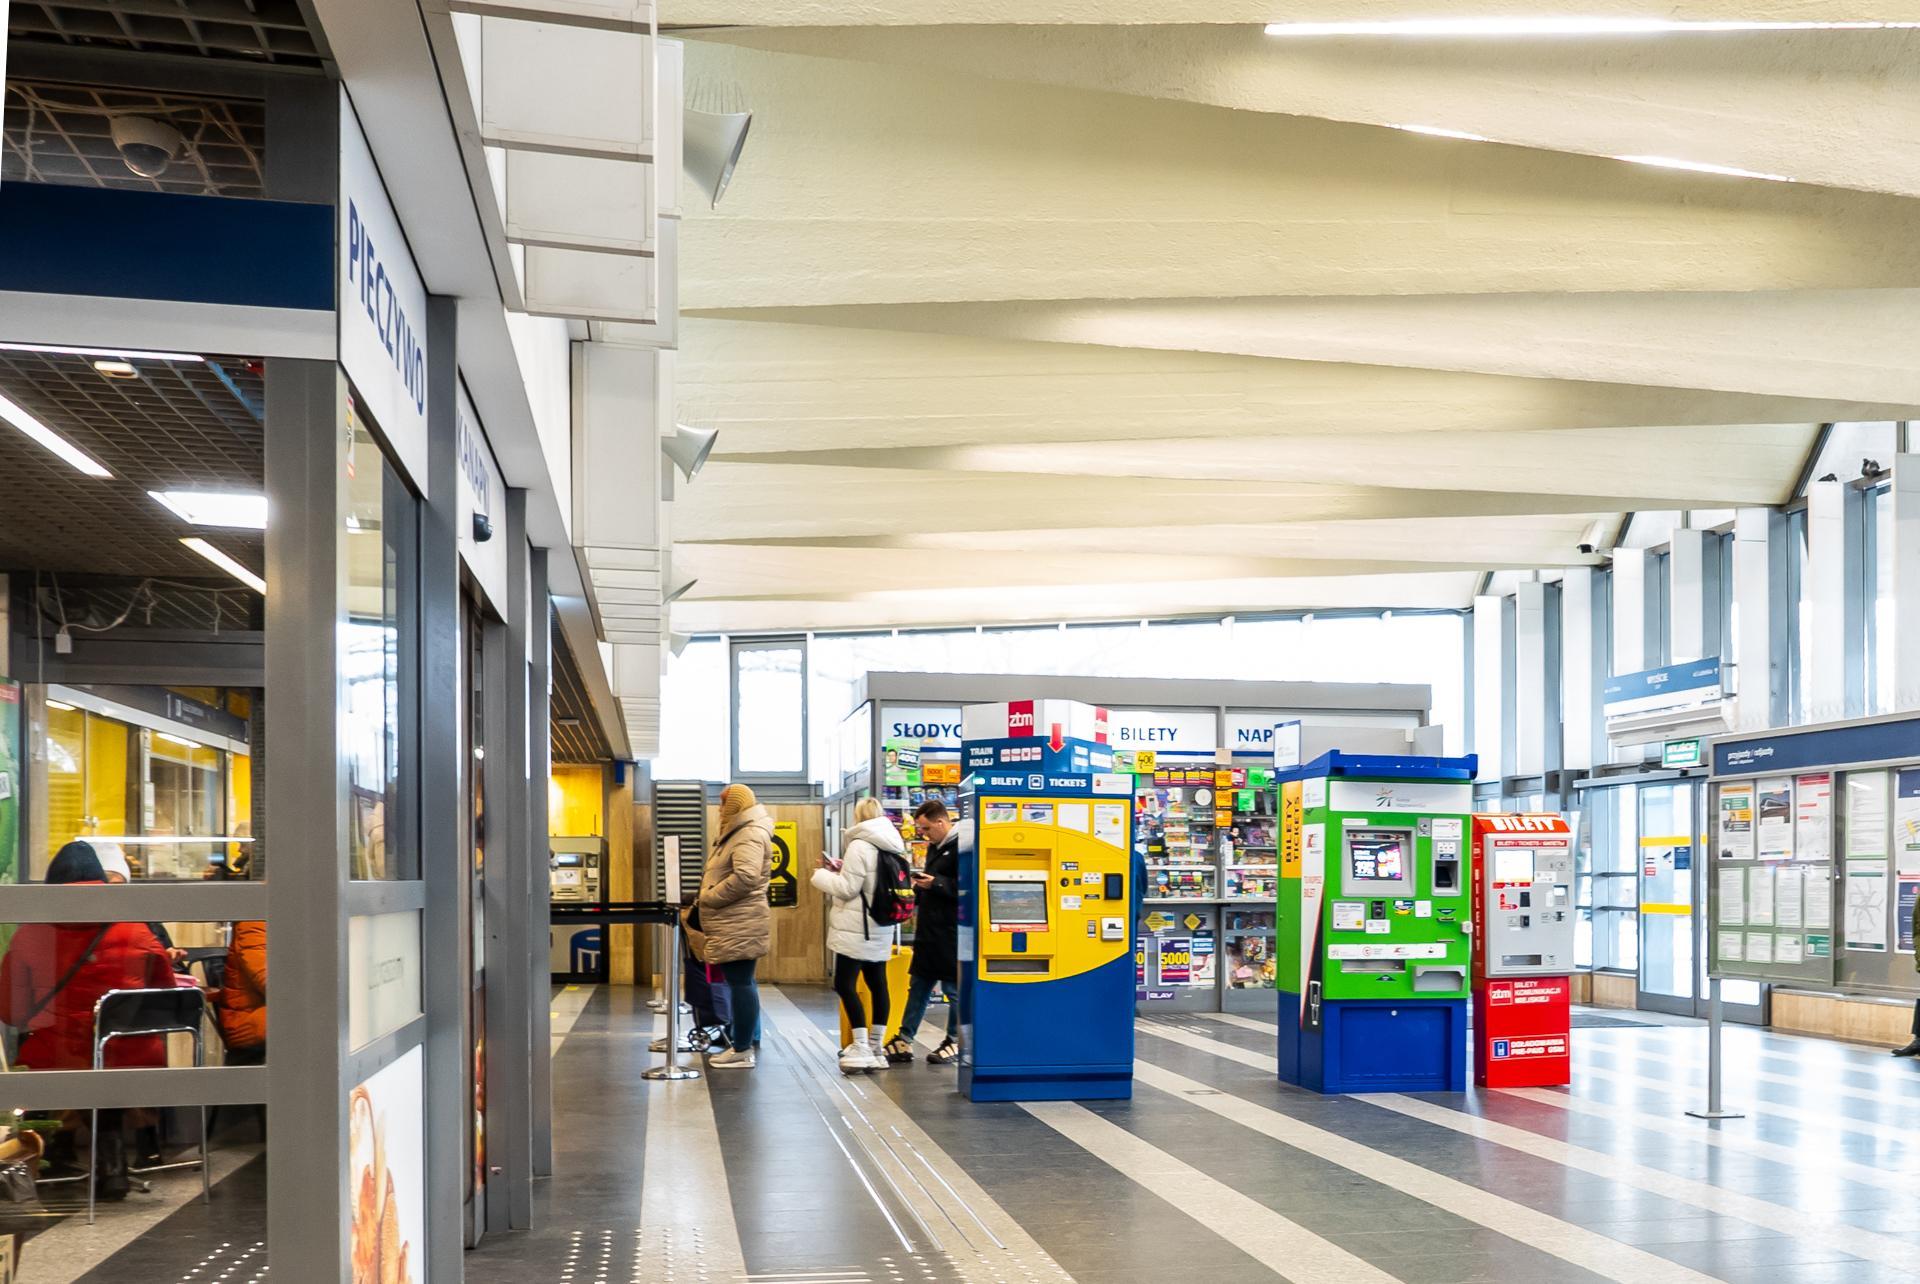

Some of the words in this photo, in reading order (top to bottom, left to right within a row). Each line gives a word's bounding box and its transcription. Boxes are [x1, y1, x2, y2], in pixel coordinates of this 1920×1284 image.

[349, 196, 424, 416] PIECZYWO
[1009, 712, 1033, 727] ztm
[893, 723, 962, 738] SŁODYC
[1120, 727, 1178, 741] BILETY
[1238, 729, 1273, 742] NAP
[991, 777, 1023, 786] BILETY
[1049, 778, 1087, 788] TICKETS
[1491, 817, 1555, 831] BILETY
[1161, 952, 1190, 965] 5000
